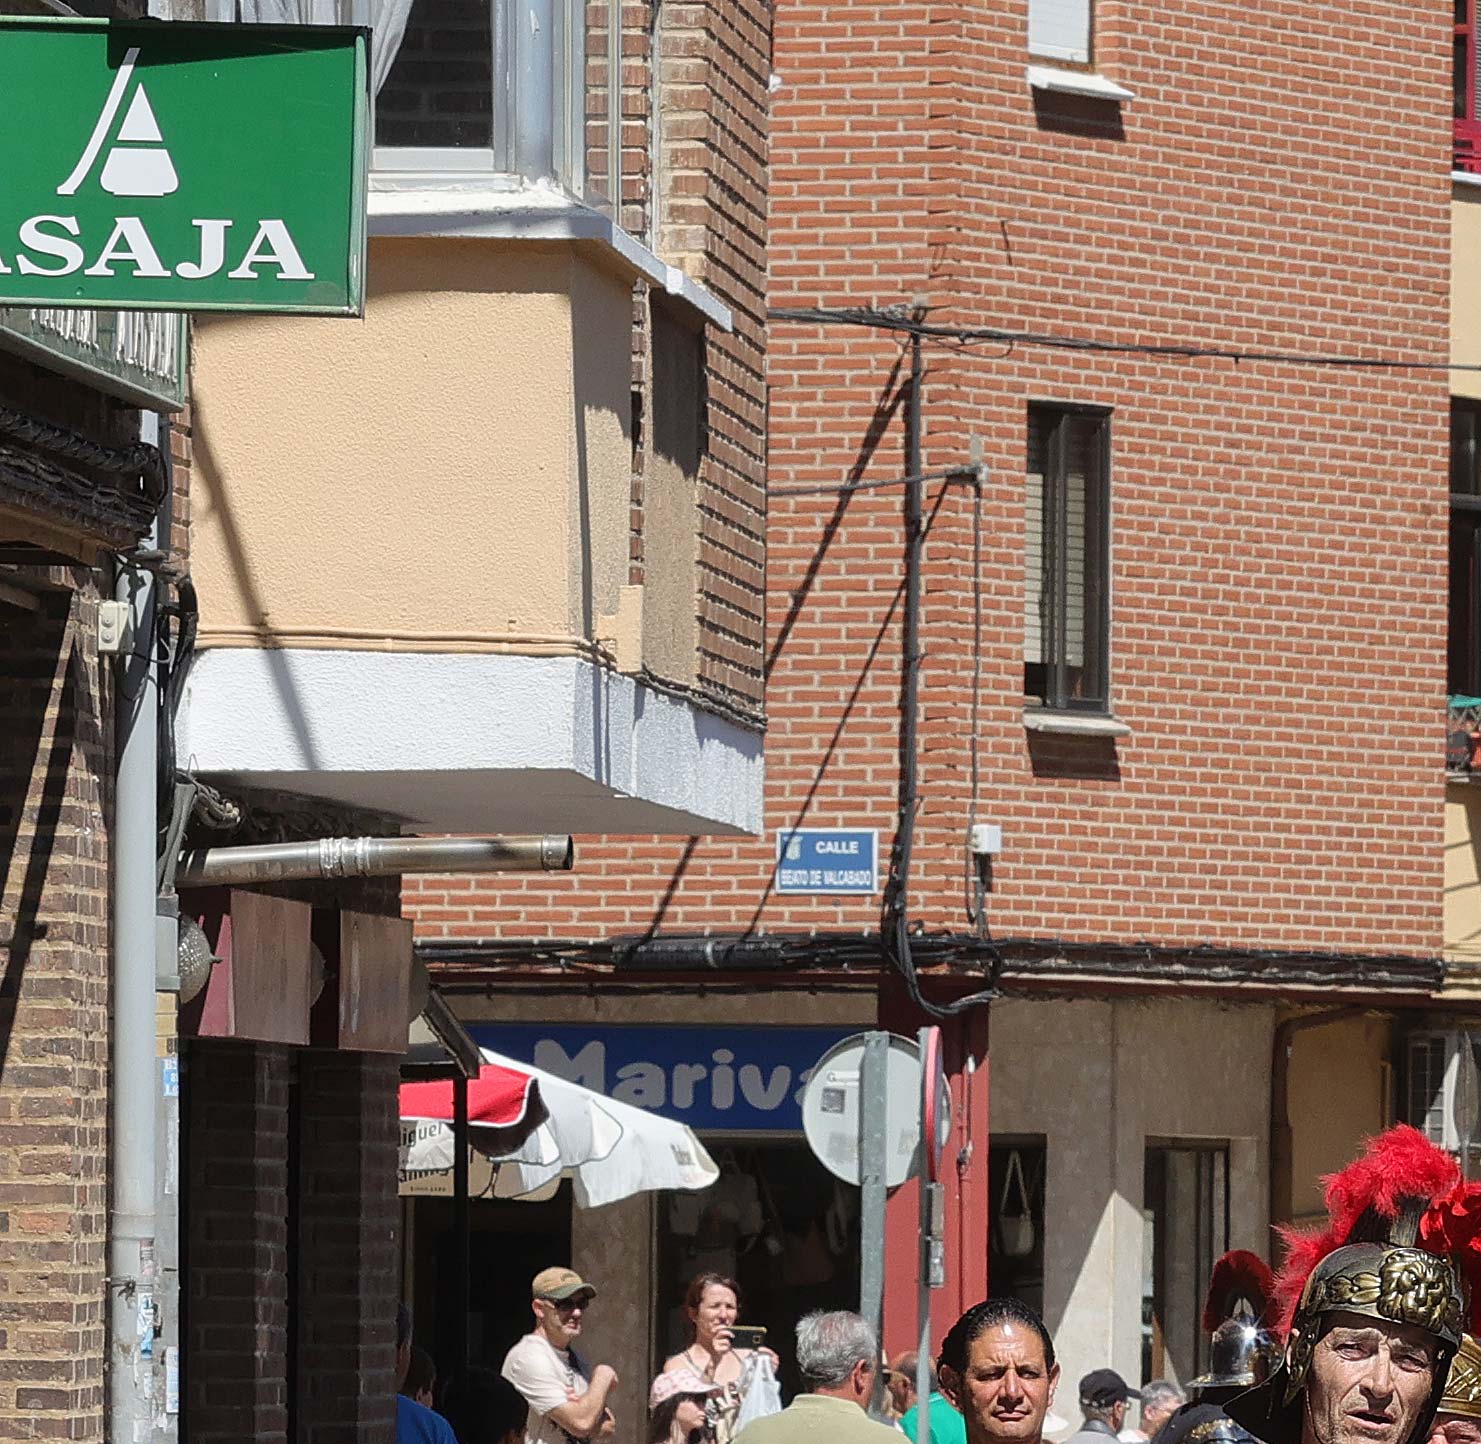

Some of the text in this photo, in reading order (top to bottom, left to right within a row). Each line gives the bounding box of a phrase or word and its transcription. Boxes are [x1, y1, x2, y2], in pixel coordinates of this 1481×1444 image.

[0, 214, 315, 280] SAJA
[815, 840, 859, 854] CALLE
[809, 870, 821, 886] DE
[534, 1039, 812, 1110] Mariv
